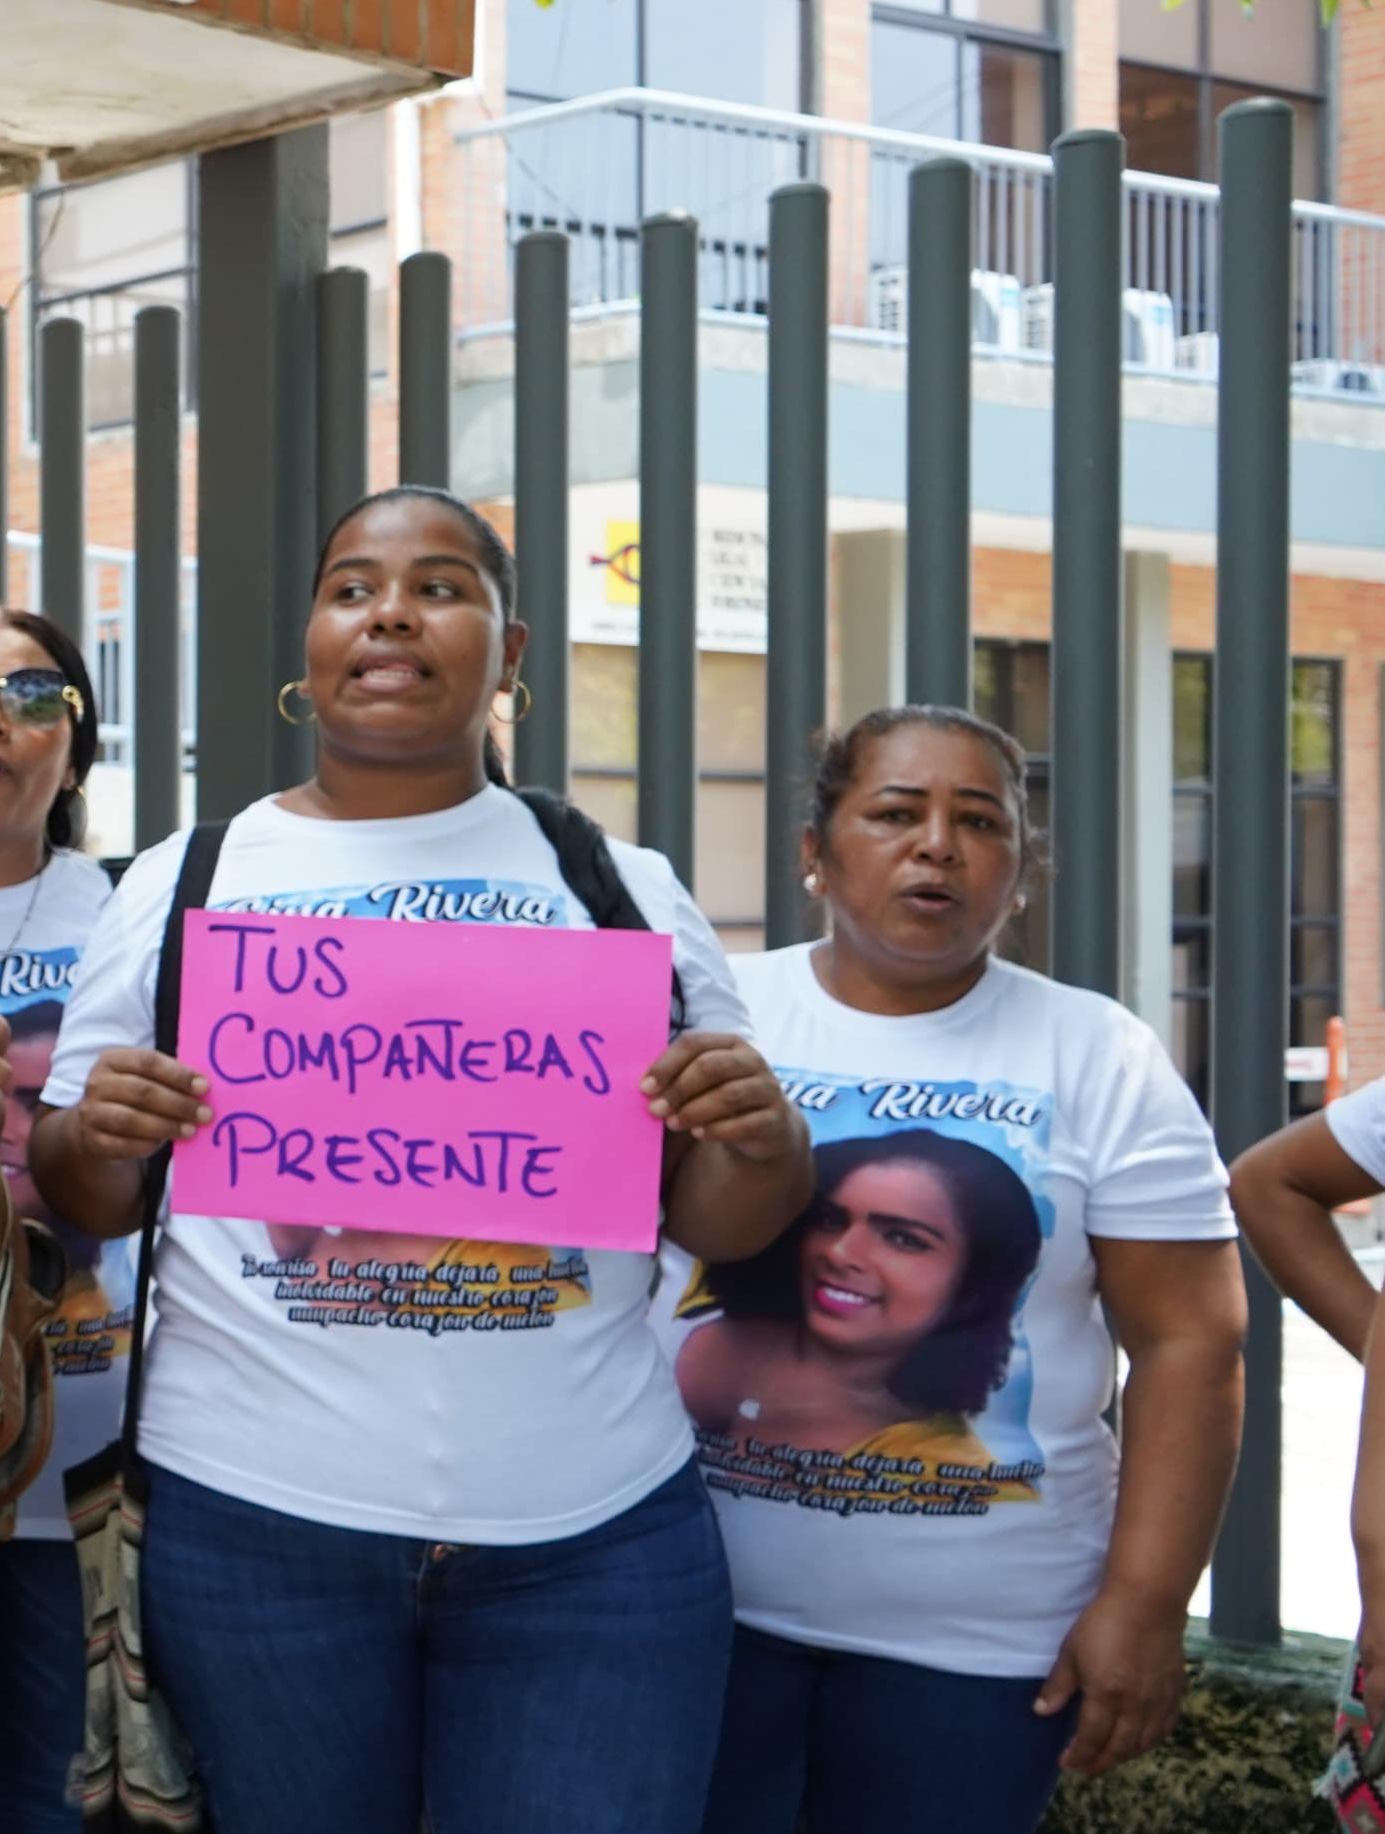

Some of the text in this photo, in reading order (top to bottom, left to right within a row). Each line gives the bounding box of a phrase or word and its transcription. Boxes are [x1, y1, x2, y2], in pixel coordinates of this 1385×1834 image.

[368, 880, 555, 924] Rivera
[209, 925, 348, 998] TUS
[209, 1013, 610, 1095] COMPAÑERAS
[859, 1080, 1042, 1125] Rivera
[213, 1112, 562, 1198] PRESENTE
